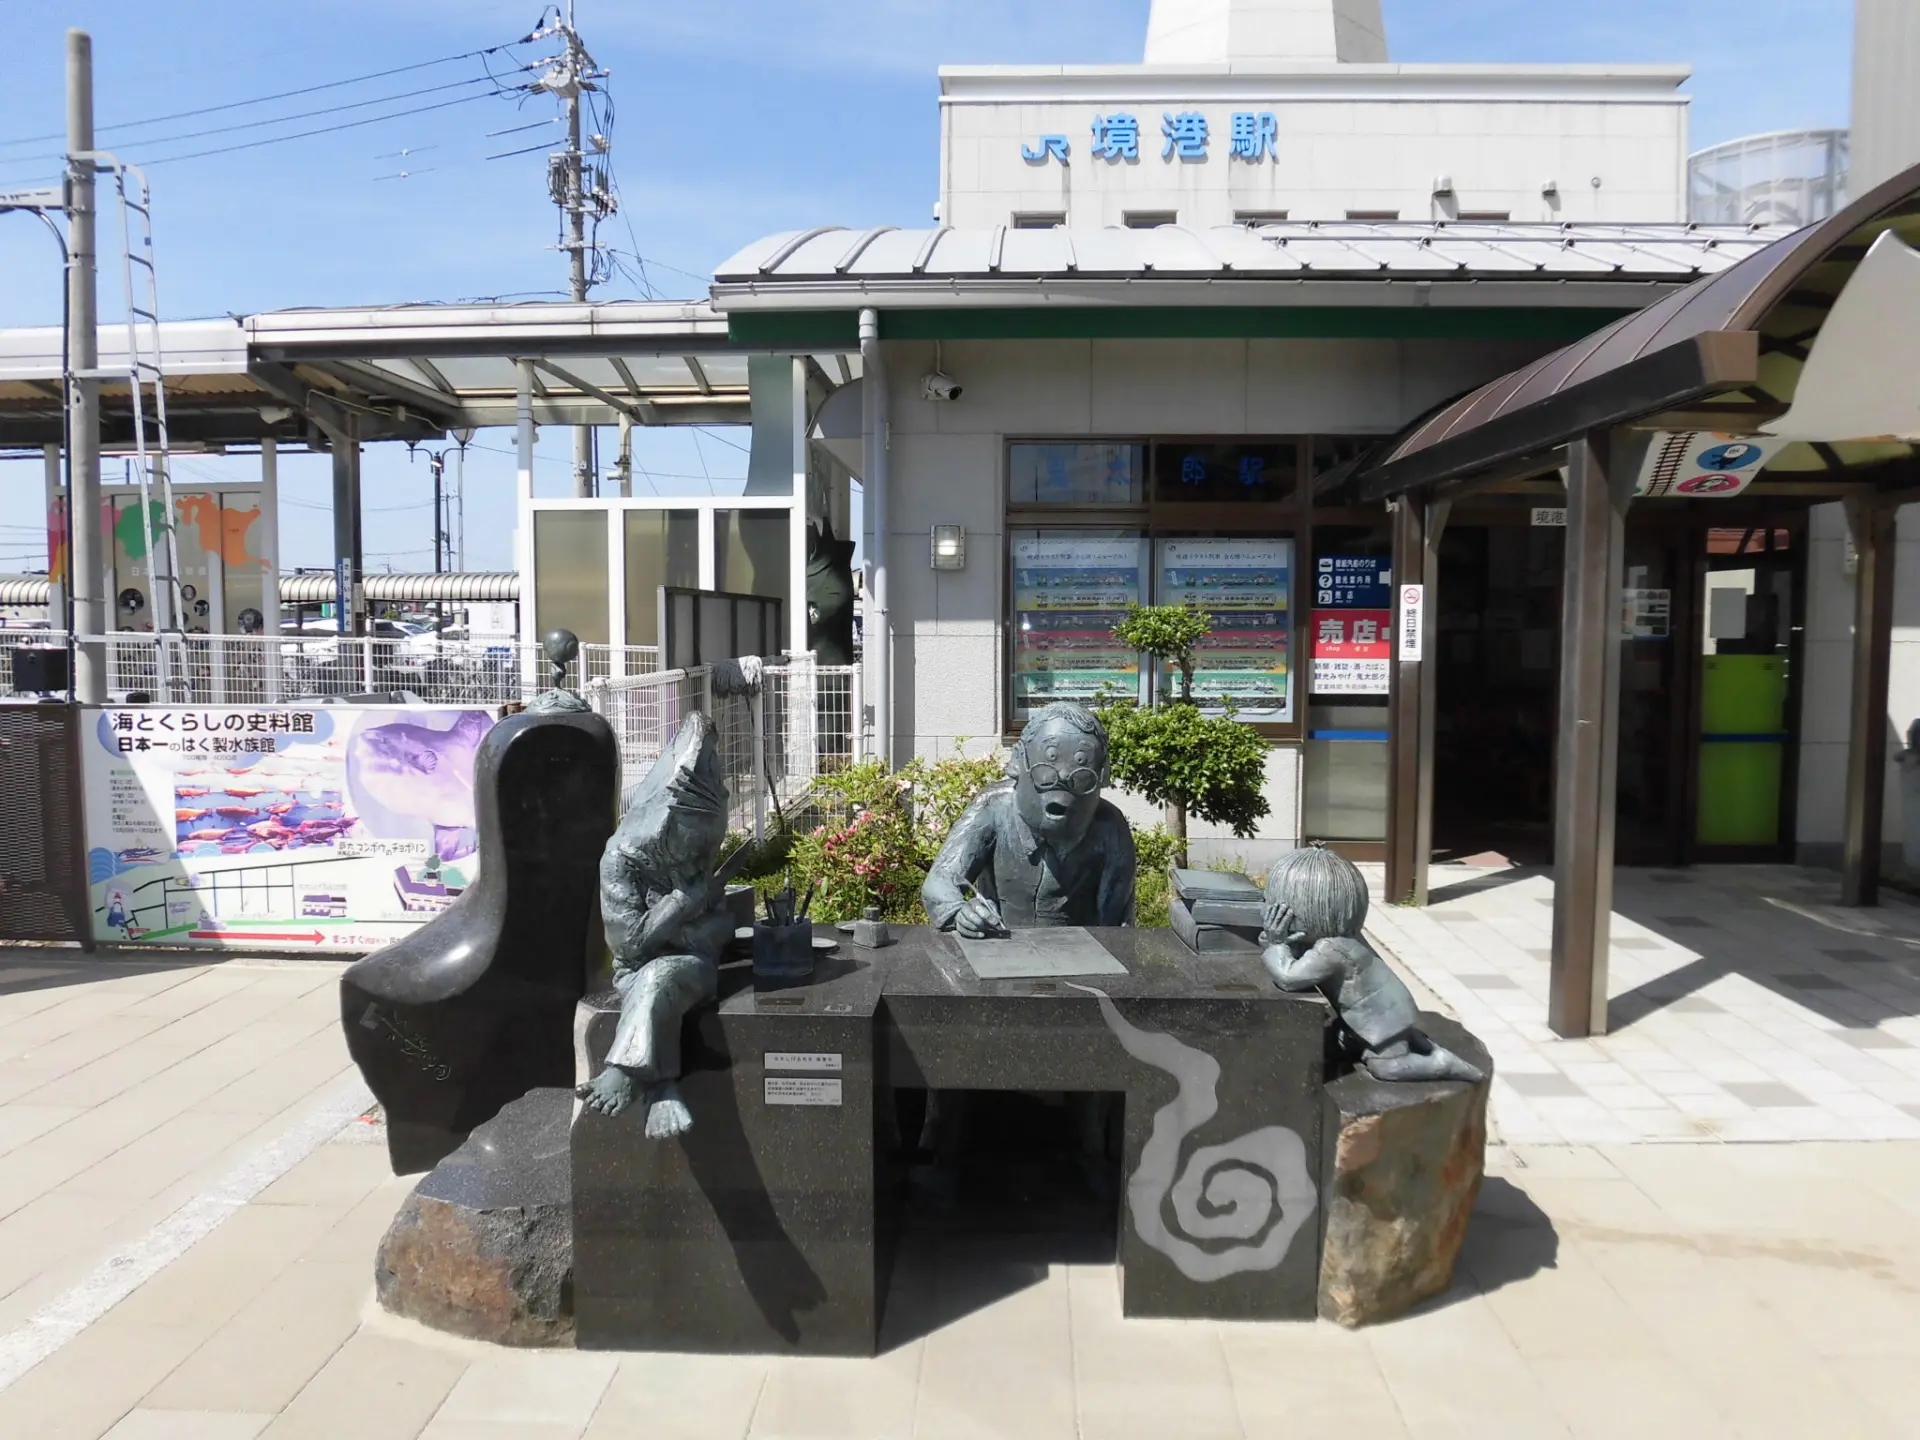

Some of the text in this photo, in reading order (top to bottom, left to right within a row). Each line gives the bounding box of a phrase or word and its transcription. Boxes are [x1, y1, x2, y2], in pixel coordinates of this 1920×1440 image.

[1318, 618, 1378, 645] 売店
[1405, 608, 1417, 649] 終日禁煙
[113, 712, 315, 733] 海とくらしの史料館
[118, 737, 276, 753] 日本一のはく製水族館
